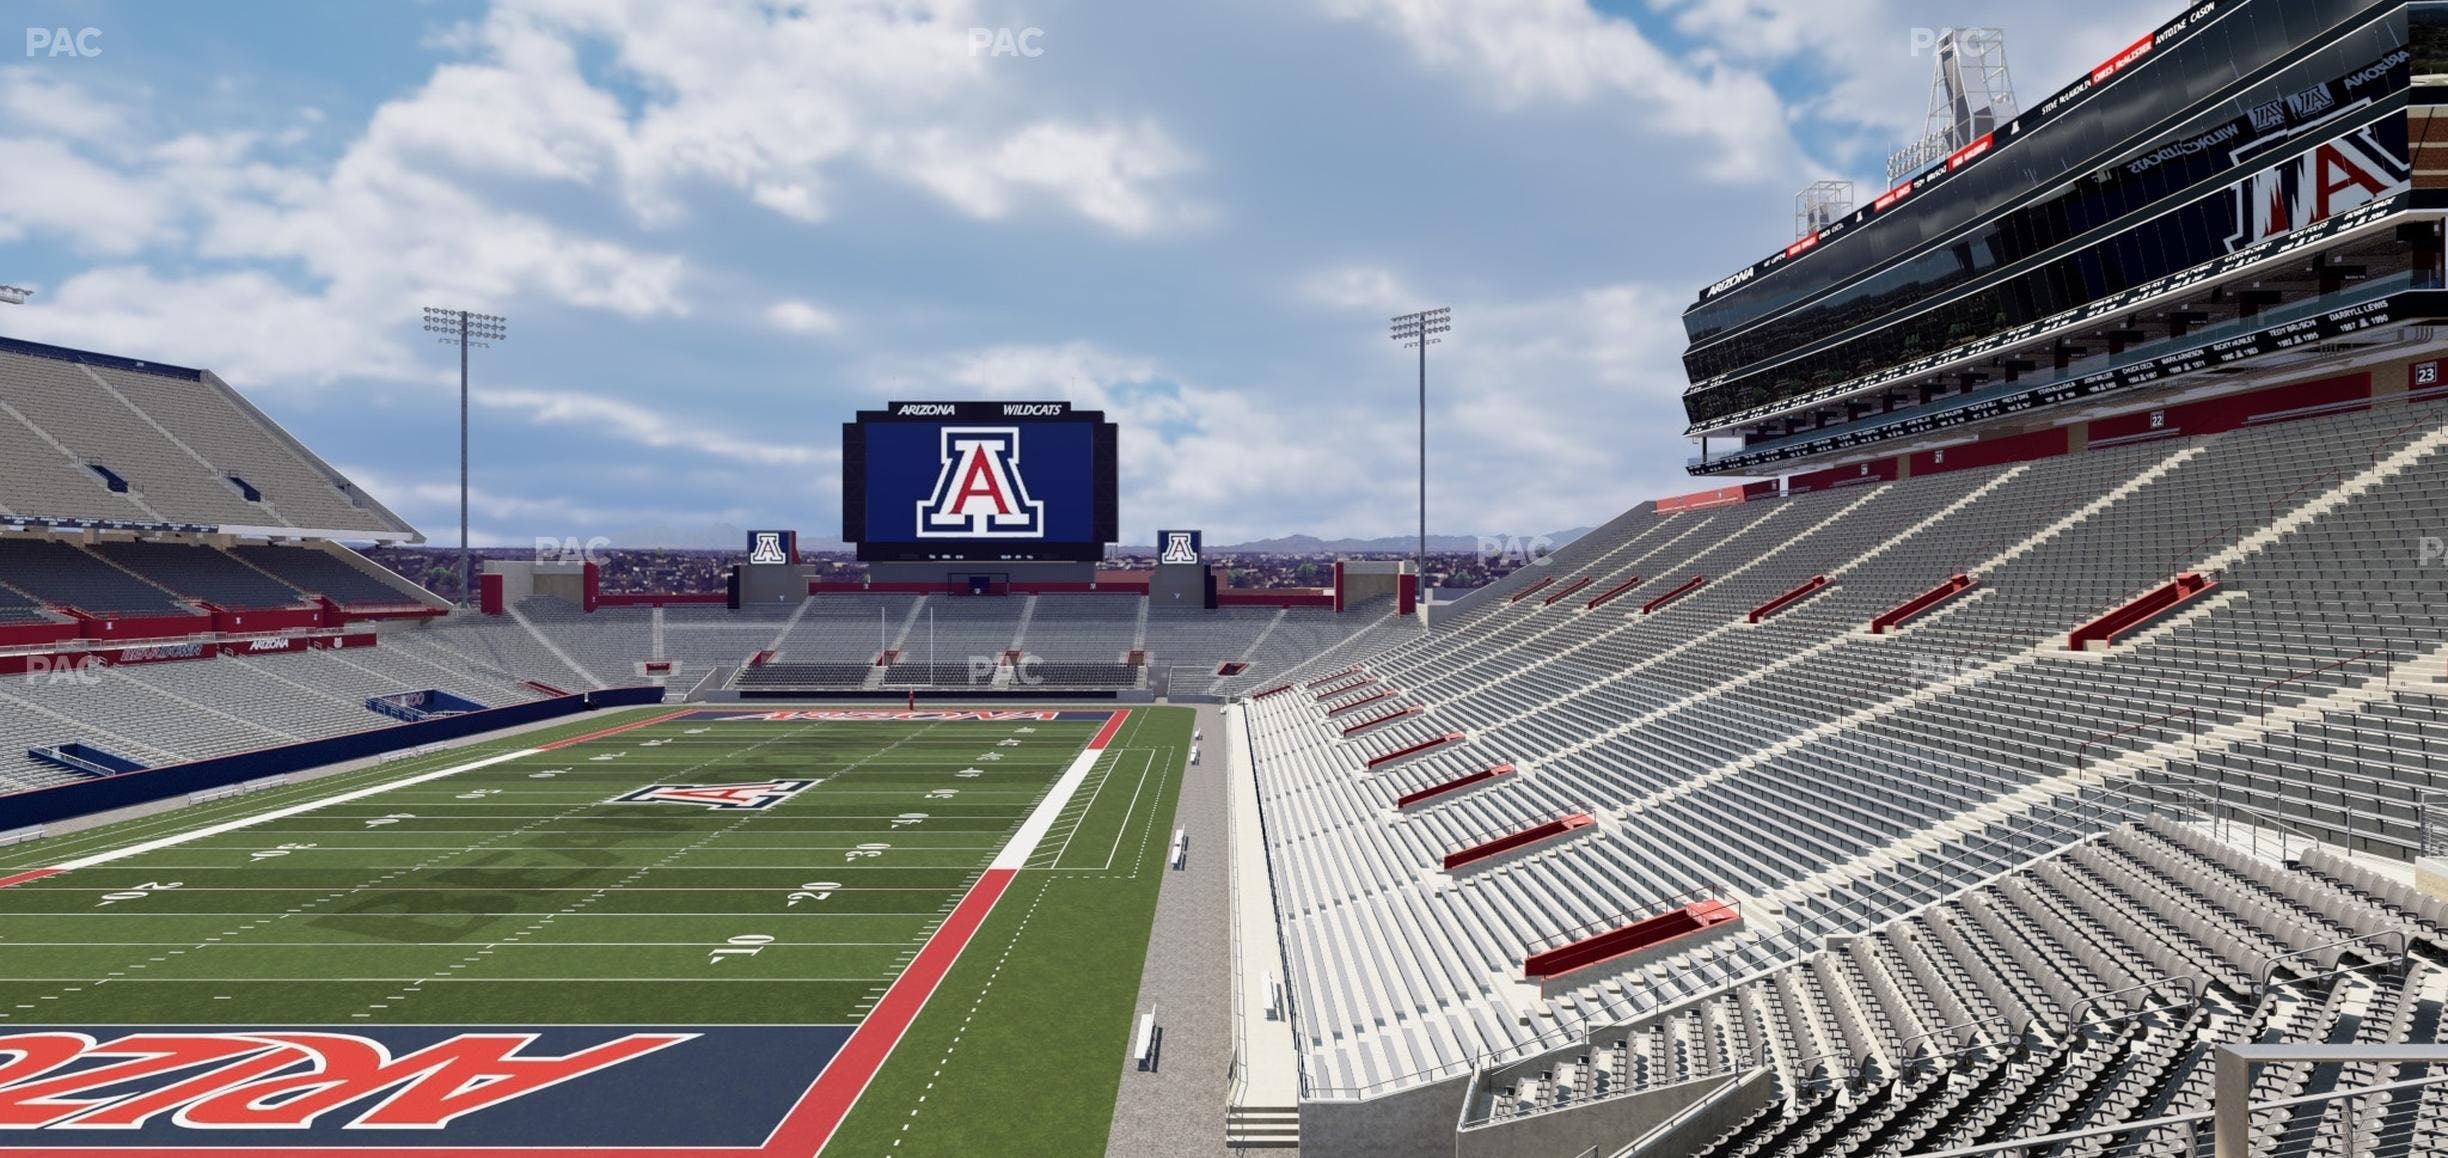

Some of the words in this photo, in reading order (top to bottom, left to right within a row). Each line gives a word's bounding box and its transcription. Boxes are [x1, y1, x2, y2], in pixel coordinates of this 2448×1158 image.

[2190, 1, 2215, 23] CASON
[1707, 267, 1754, 297] ARIZONA
[2329, 307, 2362, 322] DARRYLL
[2363, 300, 2389, 313] LEWIS
[2419, 368, 2434, 382] 23
[898, 404, 955, 416] ARIZONA
[1003, 404, 1062, 416] WILDCATS
[2152, 415, 2162, 427] 22
[917, 427, 1044, 538] A
[750, 533, 786, 564] A
[1161, 533, 1198, 565] A
[250, 637, 289, 651] ARIZONA
[601, 778, 825, 811] A
[845, 843, 891, 858] 30
[787, 881, 842, 901] 20
[708, 934, 775, 957] 10
